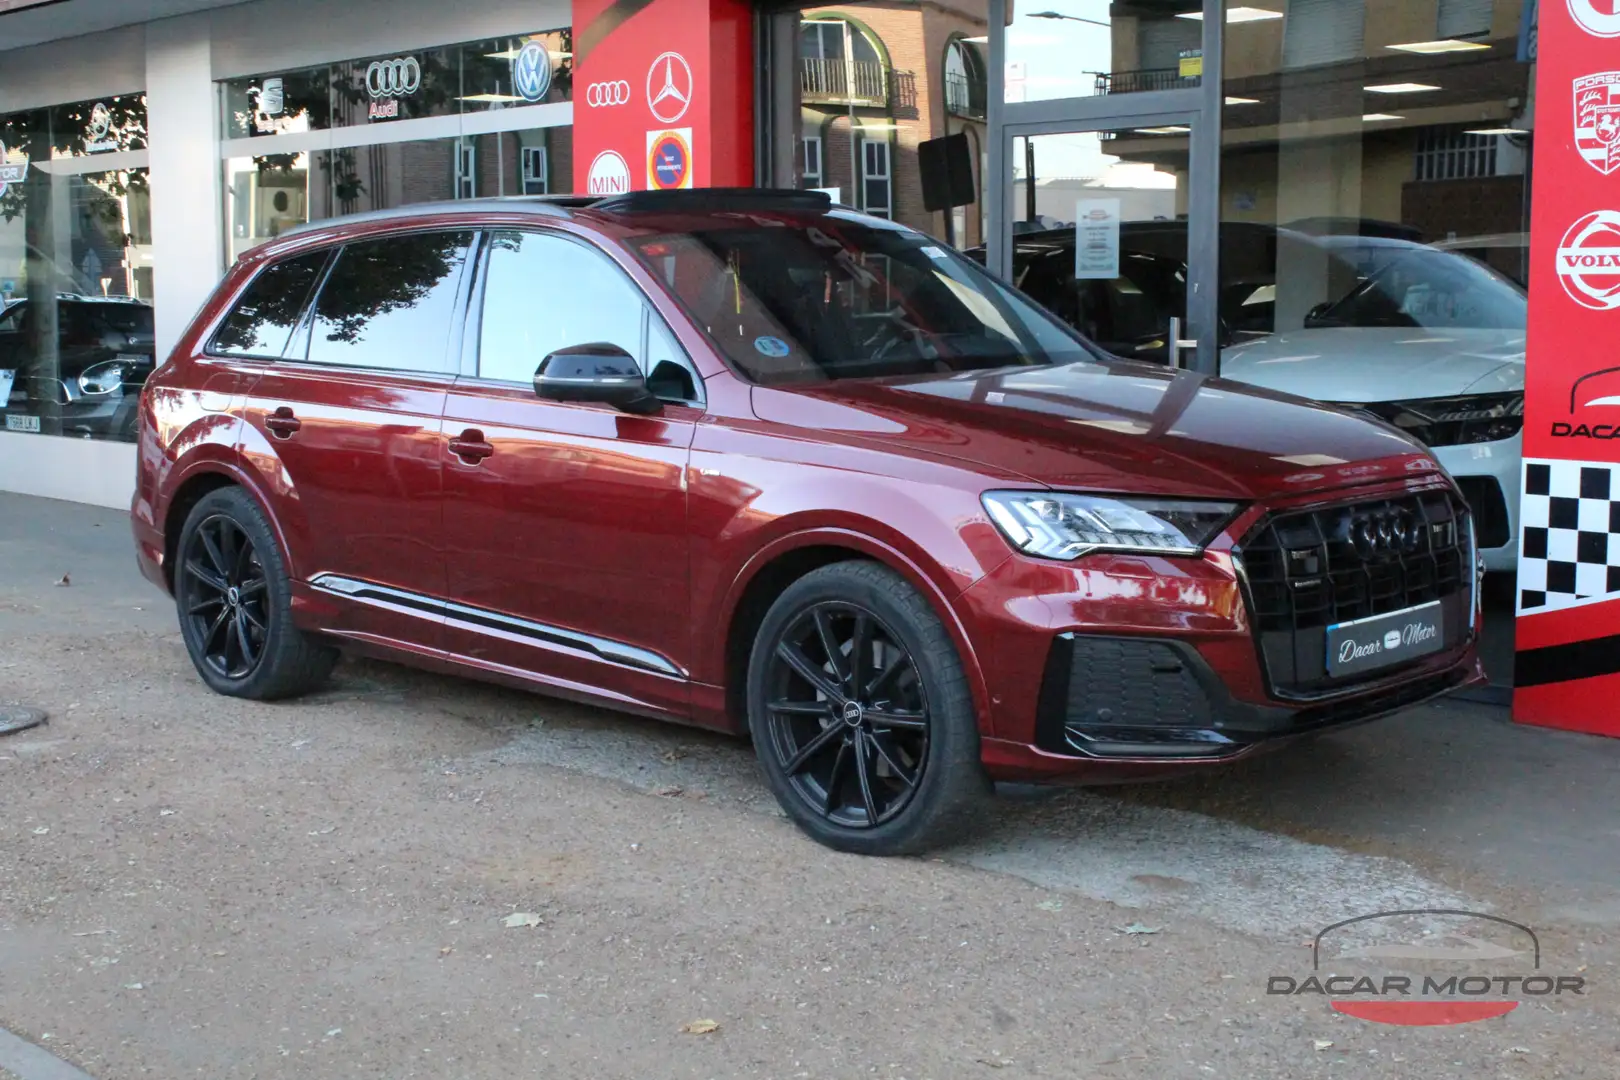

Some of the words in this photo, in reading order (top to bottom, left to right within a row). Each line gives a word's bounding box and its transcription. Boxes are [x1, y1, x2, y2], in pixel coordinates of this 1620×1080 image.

[368, 100, 399, 119] Audi
[0, 167, 19, 180] OR
[592, 175, 626, 194] MINI
[1562, 254, 1620, 267] VOLV
[1338, 639, 1381, 663] Dacar
[1402, 620, 1436, 646] Motor
